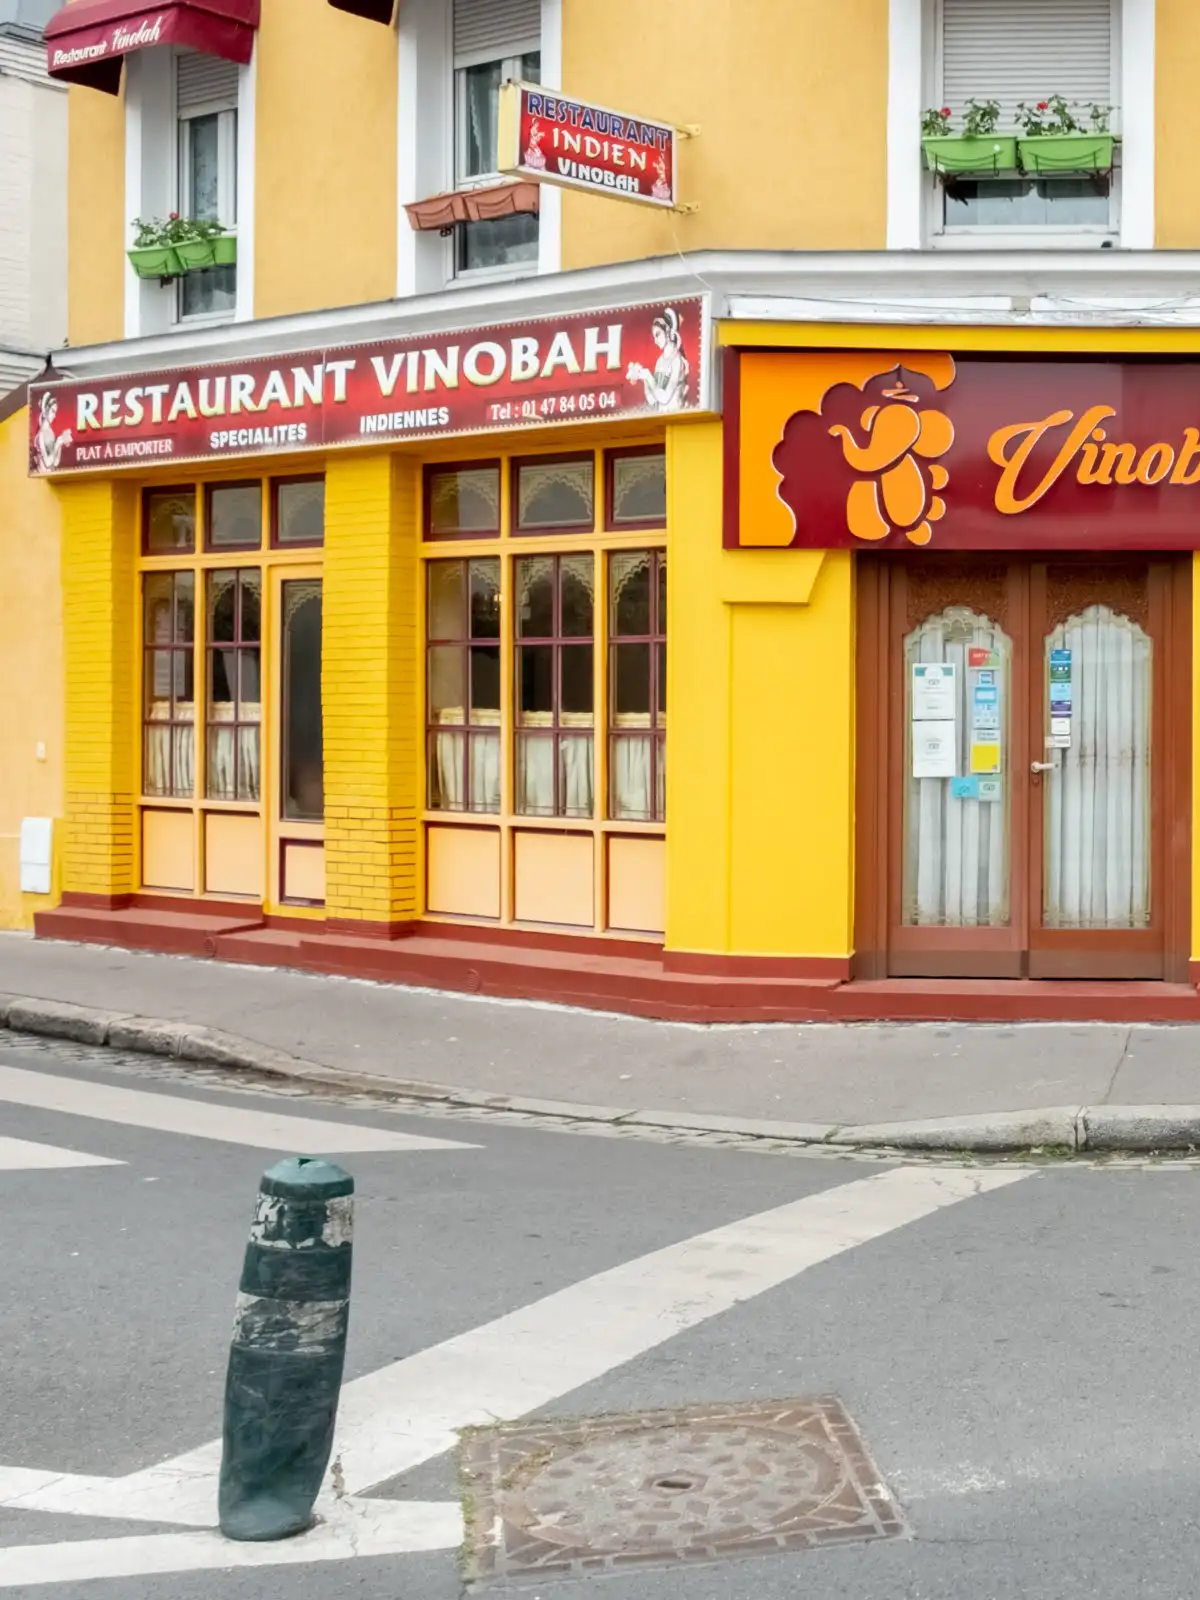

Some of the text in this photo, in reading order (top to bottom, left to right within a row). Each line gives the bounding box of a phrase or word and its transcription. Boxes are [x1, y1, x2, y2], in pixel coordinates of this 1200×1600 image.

[53, 16, 163, 66] Restaurant Vinobah
[528, 92, 669, 151] RESTAURANT
[552, 127, 647, 171] INDIEN
[557, 157, 640, 193] VINOBAH
[76, 324, 623, 431] RESTAURANT VINOBAH
[360, 407, 449, 433] INDIENNES
[491, 402, 511, 420] Tel
[522, 400, 536, 417] 01
[540, 397, 556, 415] 47
[559, 395, 575, 413] 84
[578, 393, 595, 411] 05
[599, 391, 616, 409] 04
[76, 446, 102, 461] PLAT
[114, 438, 173, 458] EMPORTER
[210, 423, 307, 449] SPECIALITES
